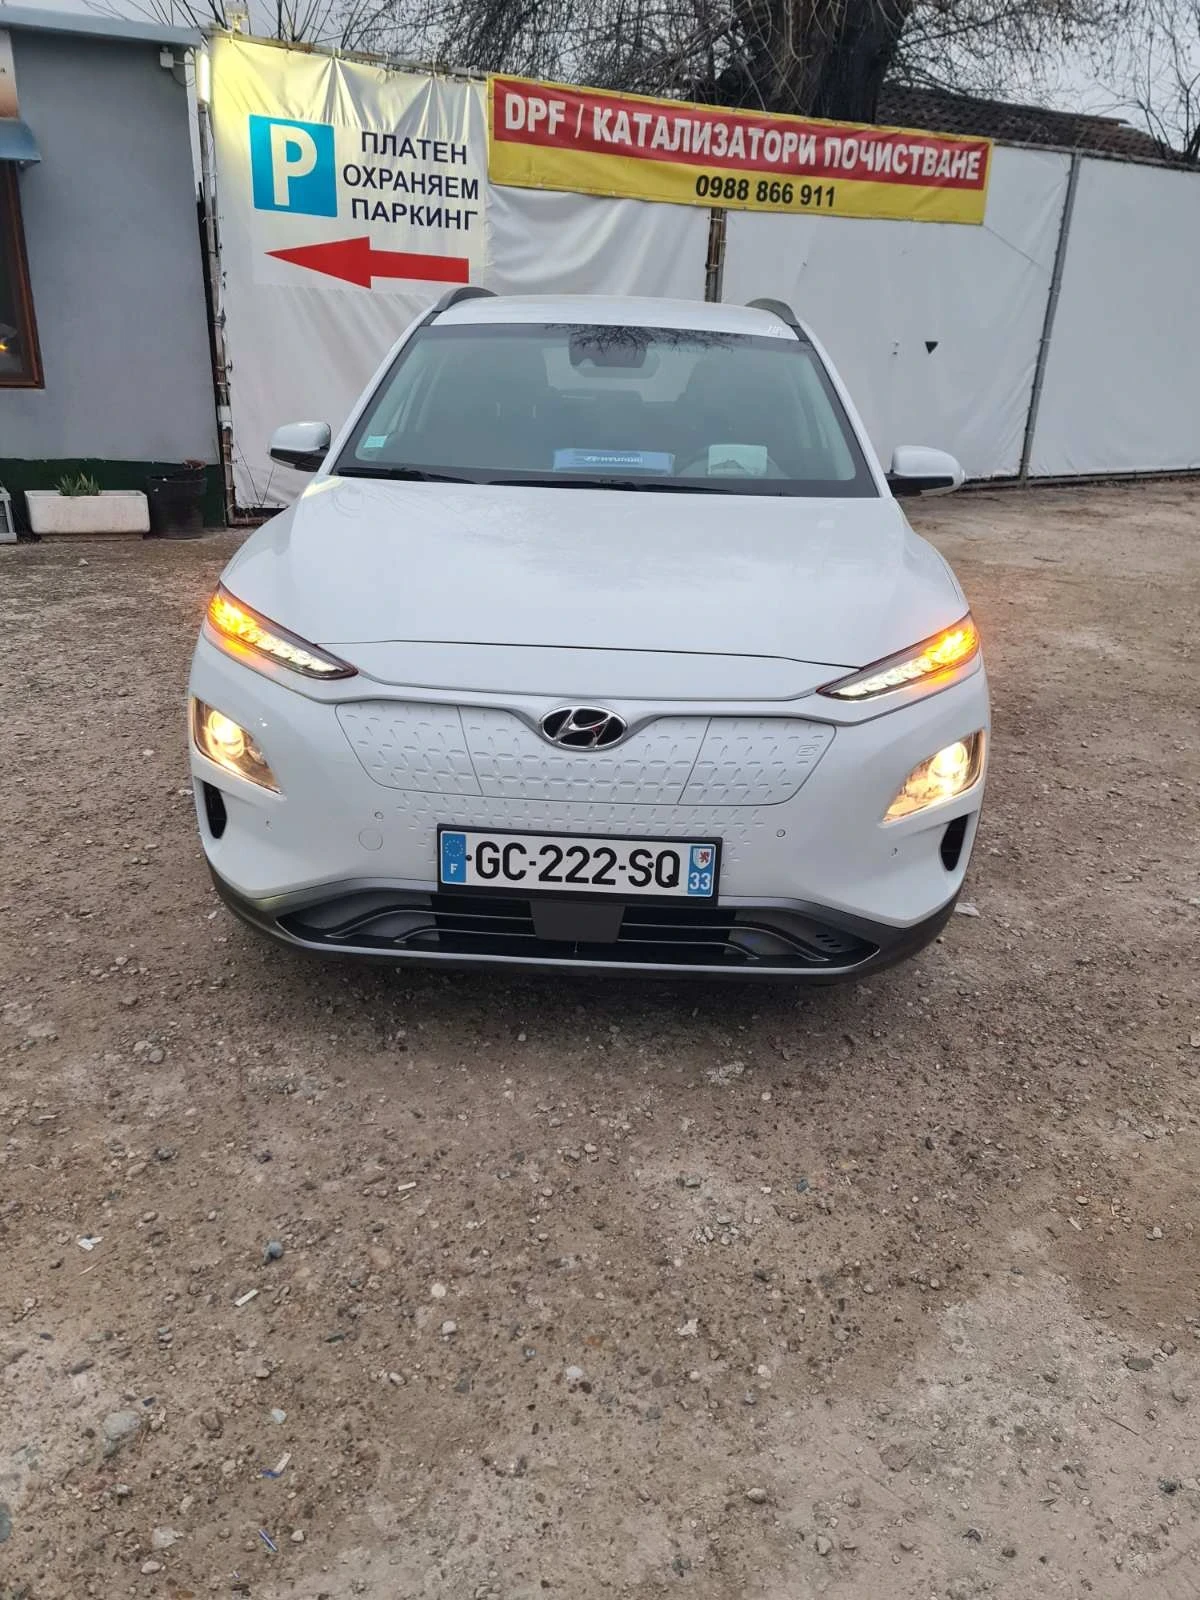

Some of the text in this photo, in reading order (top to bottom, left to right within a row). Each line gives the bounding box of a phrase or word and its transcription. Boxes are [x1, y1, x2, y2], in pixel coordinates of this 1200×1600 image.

[361, 131, 467, 165] ПЛАТЕН
[504, 93, 981, 180] DPF / КАТАЛИЗАТОРИ ПОЧИСТВАНЕ
[270, 123, 317, 207] P
[343, 164, 479, 200] ОХРАНЯЕМ
[695, 174, 835, 207] 0988 866 911
[351, 198, 478, 231] ПАРКИНГ
[449, 863, 458, 875] F
[475, 841, 681, 889] GC-222-SQ
[689, 871, 712, 891] 33
